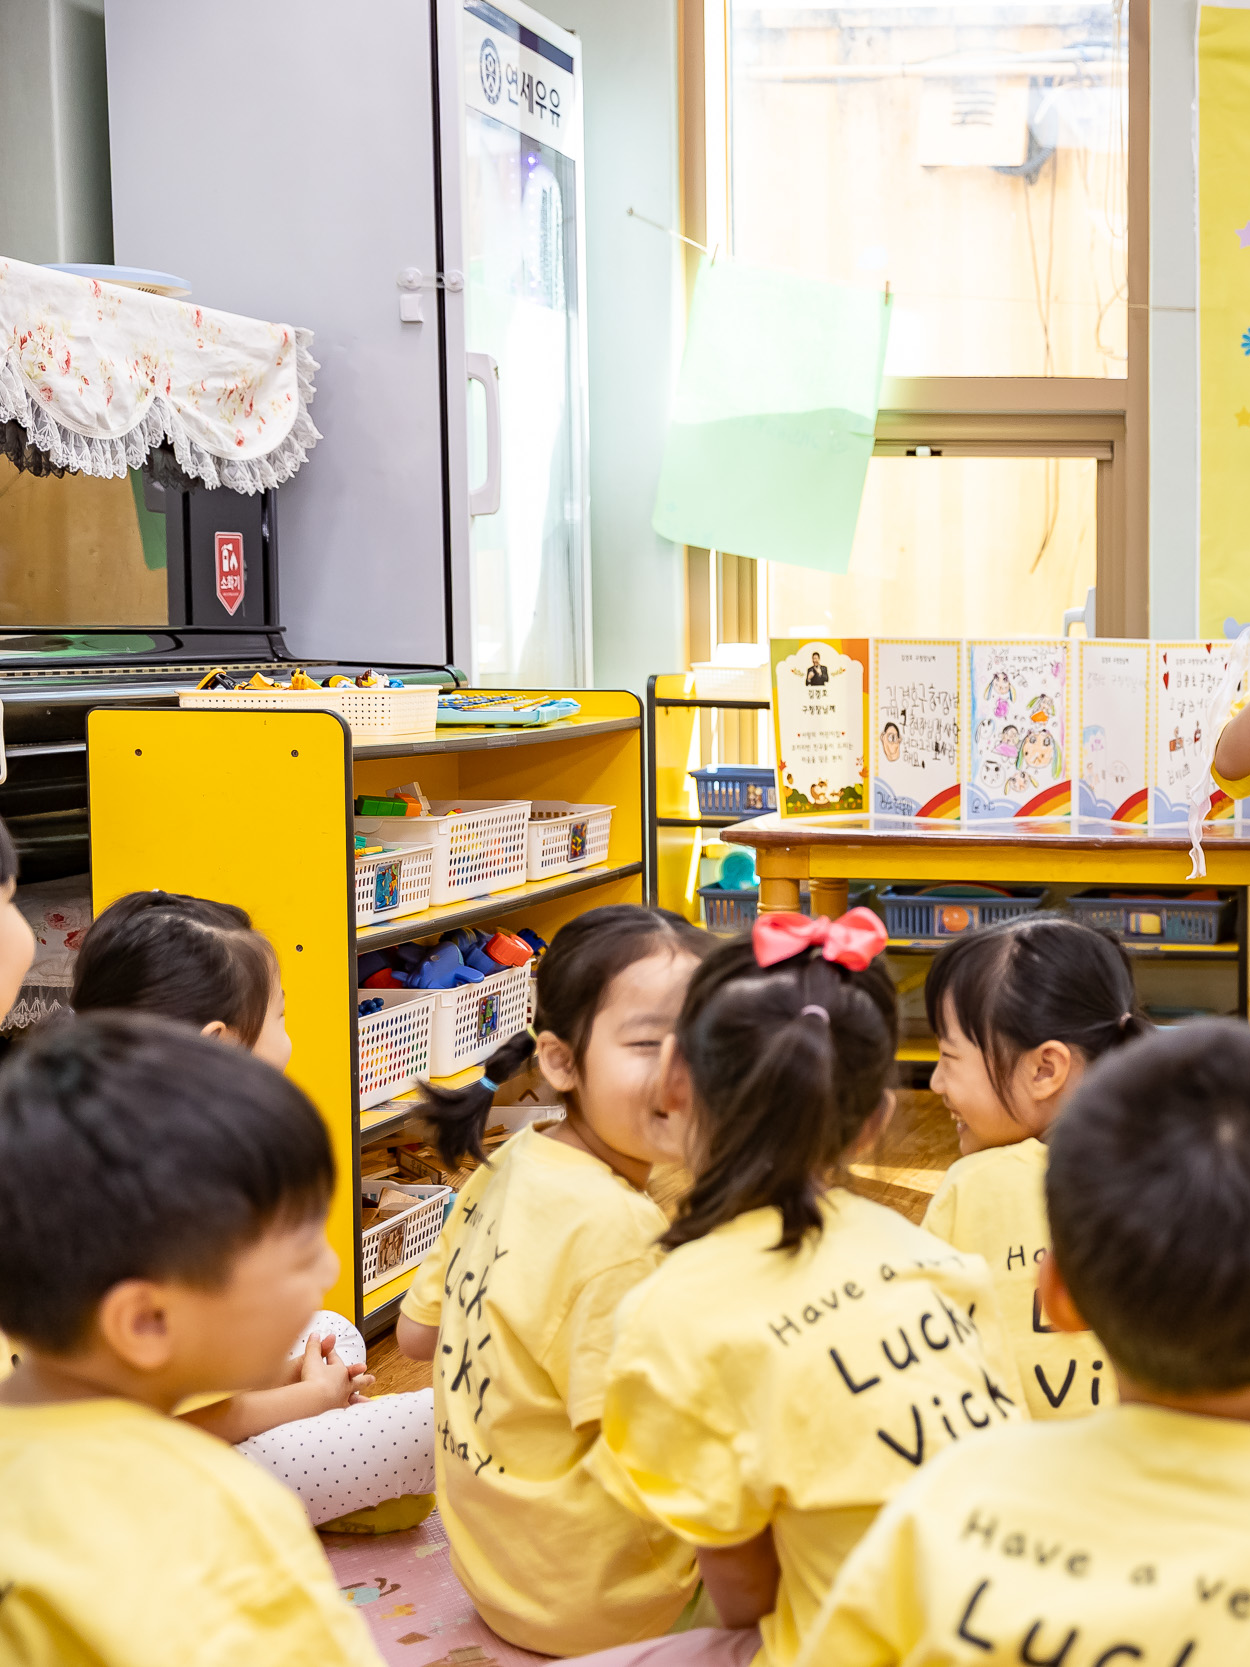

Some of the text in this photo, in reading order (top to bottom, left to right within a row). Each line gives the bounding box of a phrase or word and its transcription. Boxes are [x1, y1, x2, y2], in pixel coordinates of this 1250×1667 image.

[505, 63, 561, 128] 연세우유
[220, 575, 240, 590] 소화기
[769, 1263, 898, 1346] Have a
[829, 1288, 977, 1395] Luck
[959, 1508, 1091, 1578] Have
[1129, 1564, 1157, 1587] a
